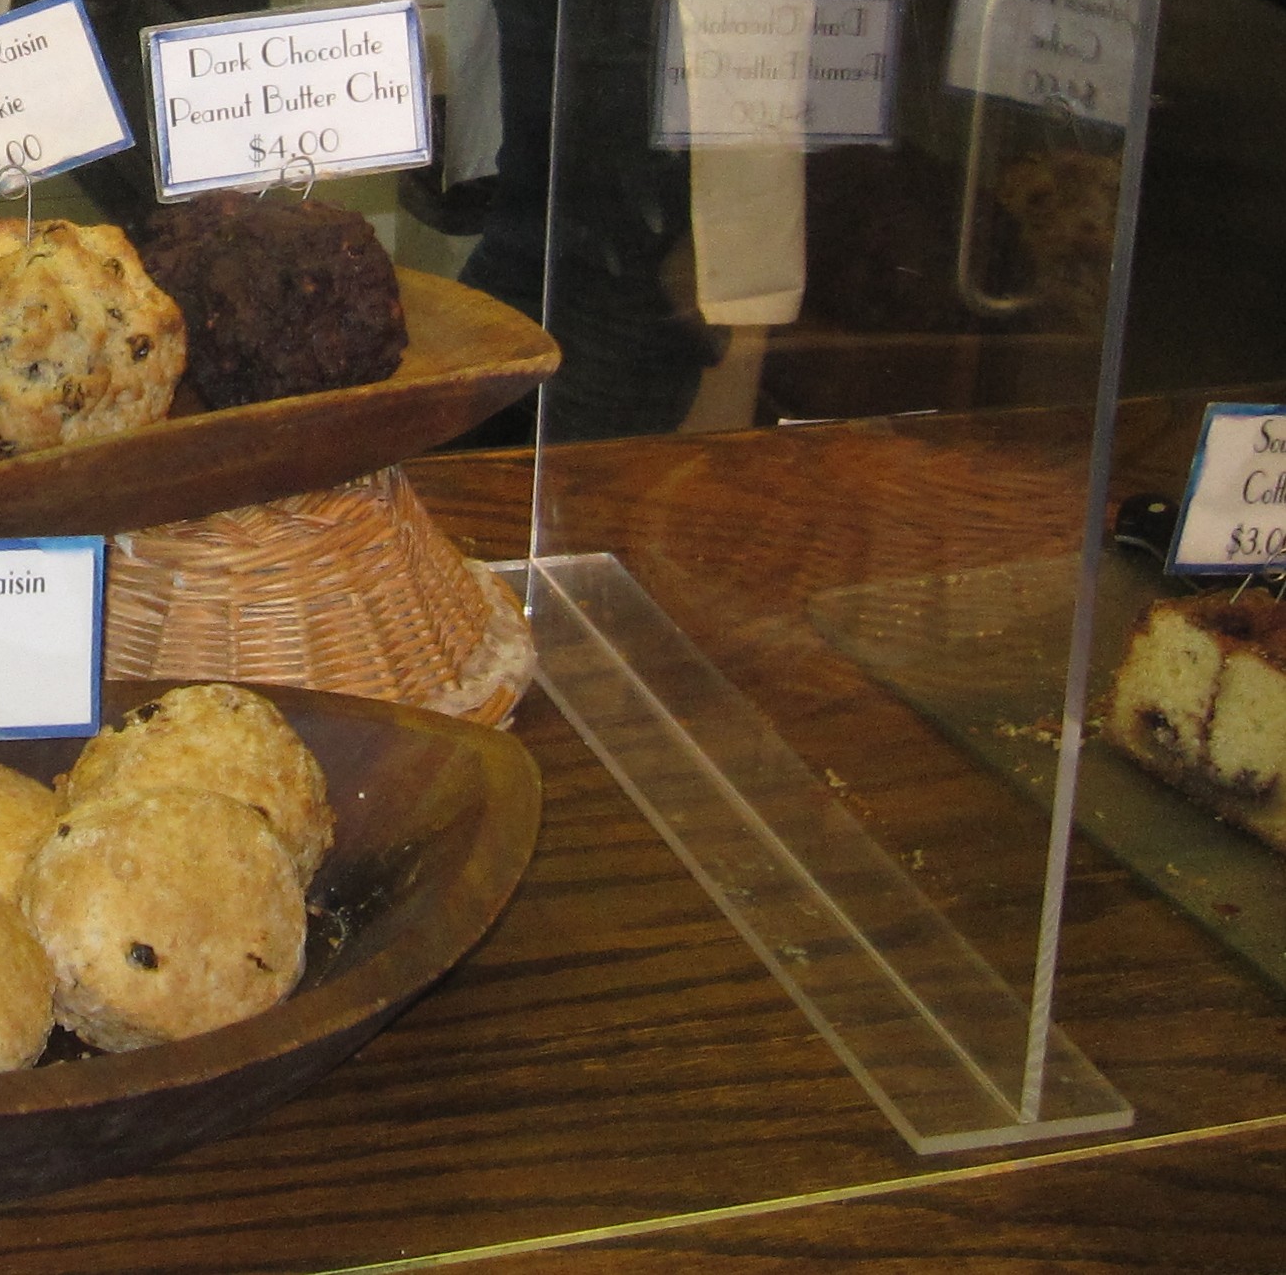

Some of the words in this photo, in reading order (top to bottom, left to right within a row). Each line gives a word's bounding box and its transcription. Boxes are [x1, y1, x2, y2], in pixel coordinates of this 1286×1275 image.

[188, 40, 252, 80] Dark
[261, 30, 384, 68] Chocolate
[169, 88, 253, 127] Peanut
[262, 82, 337, 116] Butter
[346, 73, 409, 104] Chip
[249, 128, 339, 167] $4.00
[1243, 470, 1286, 504] Coff
